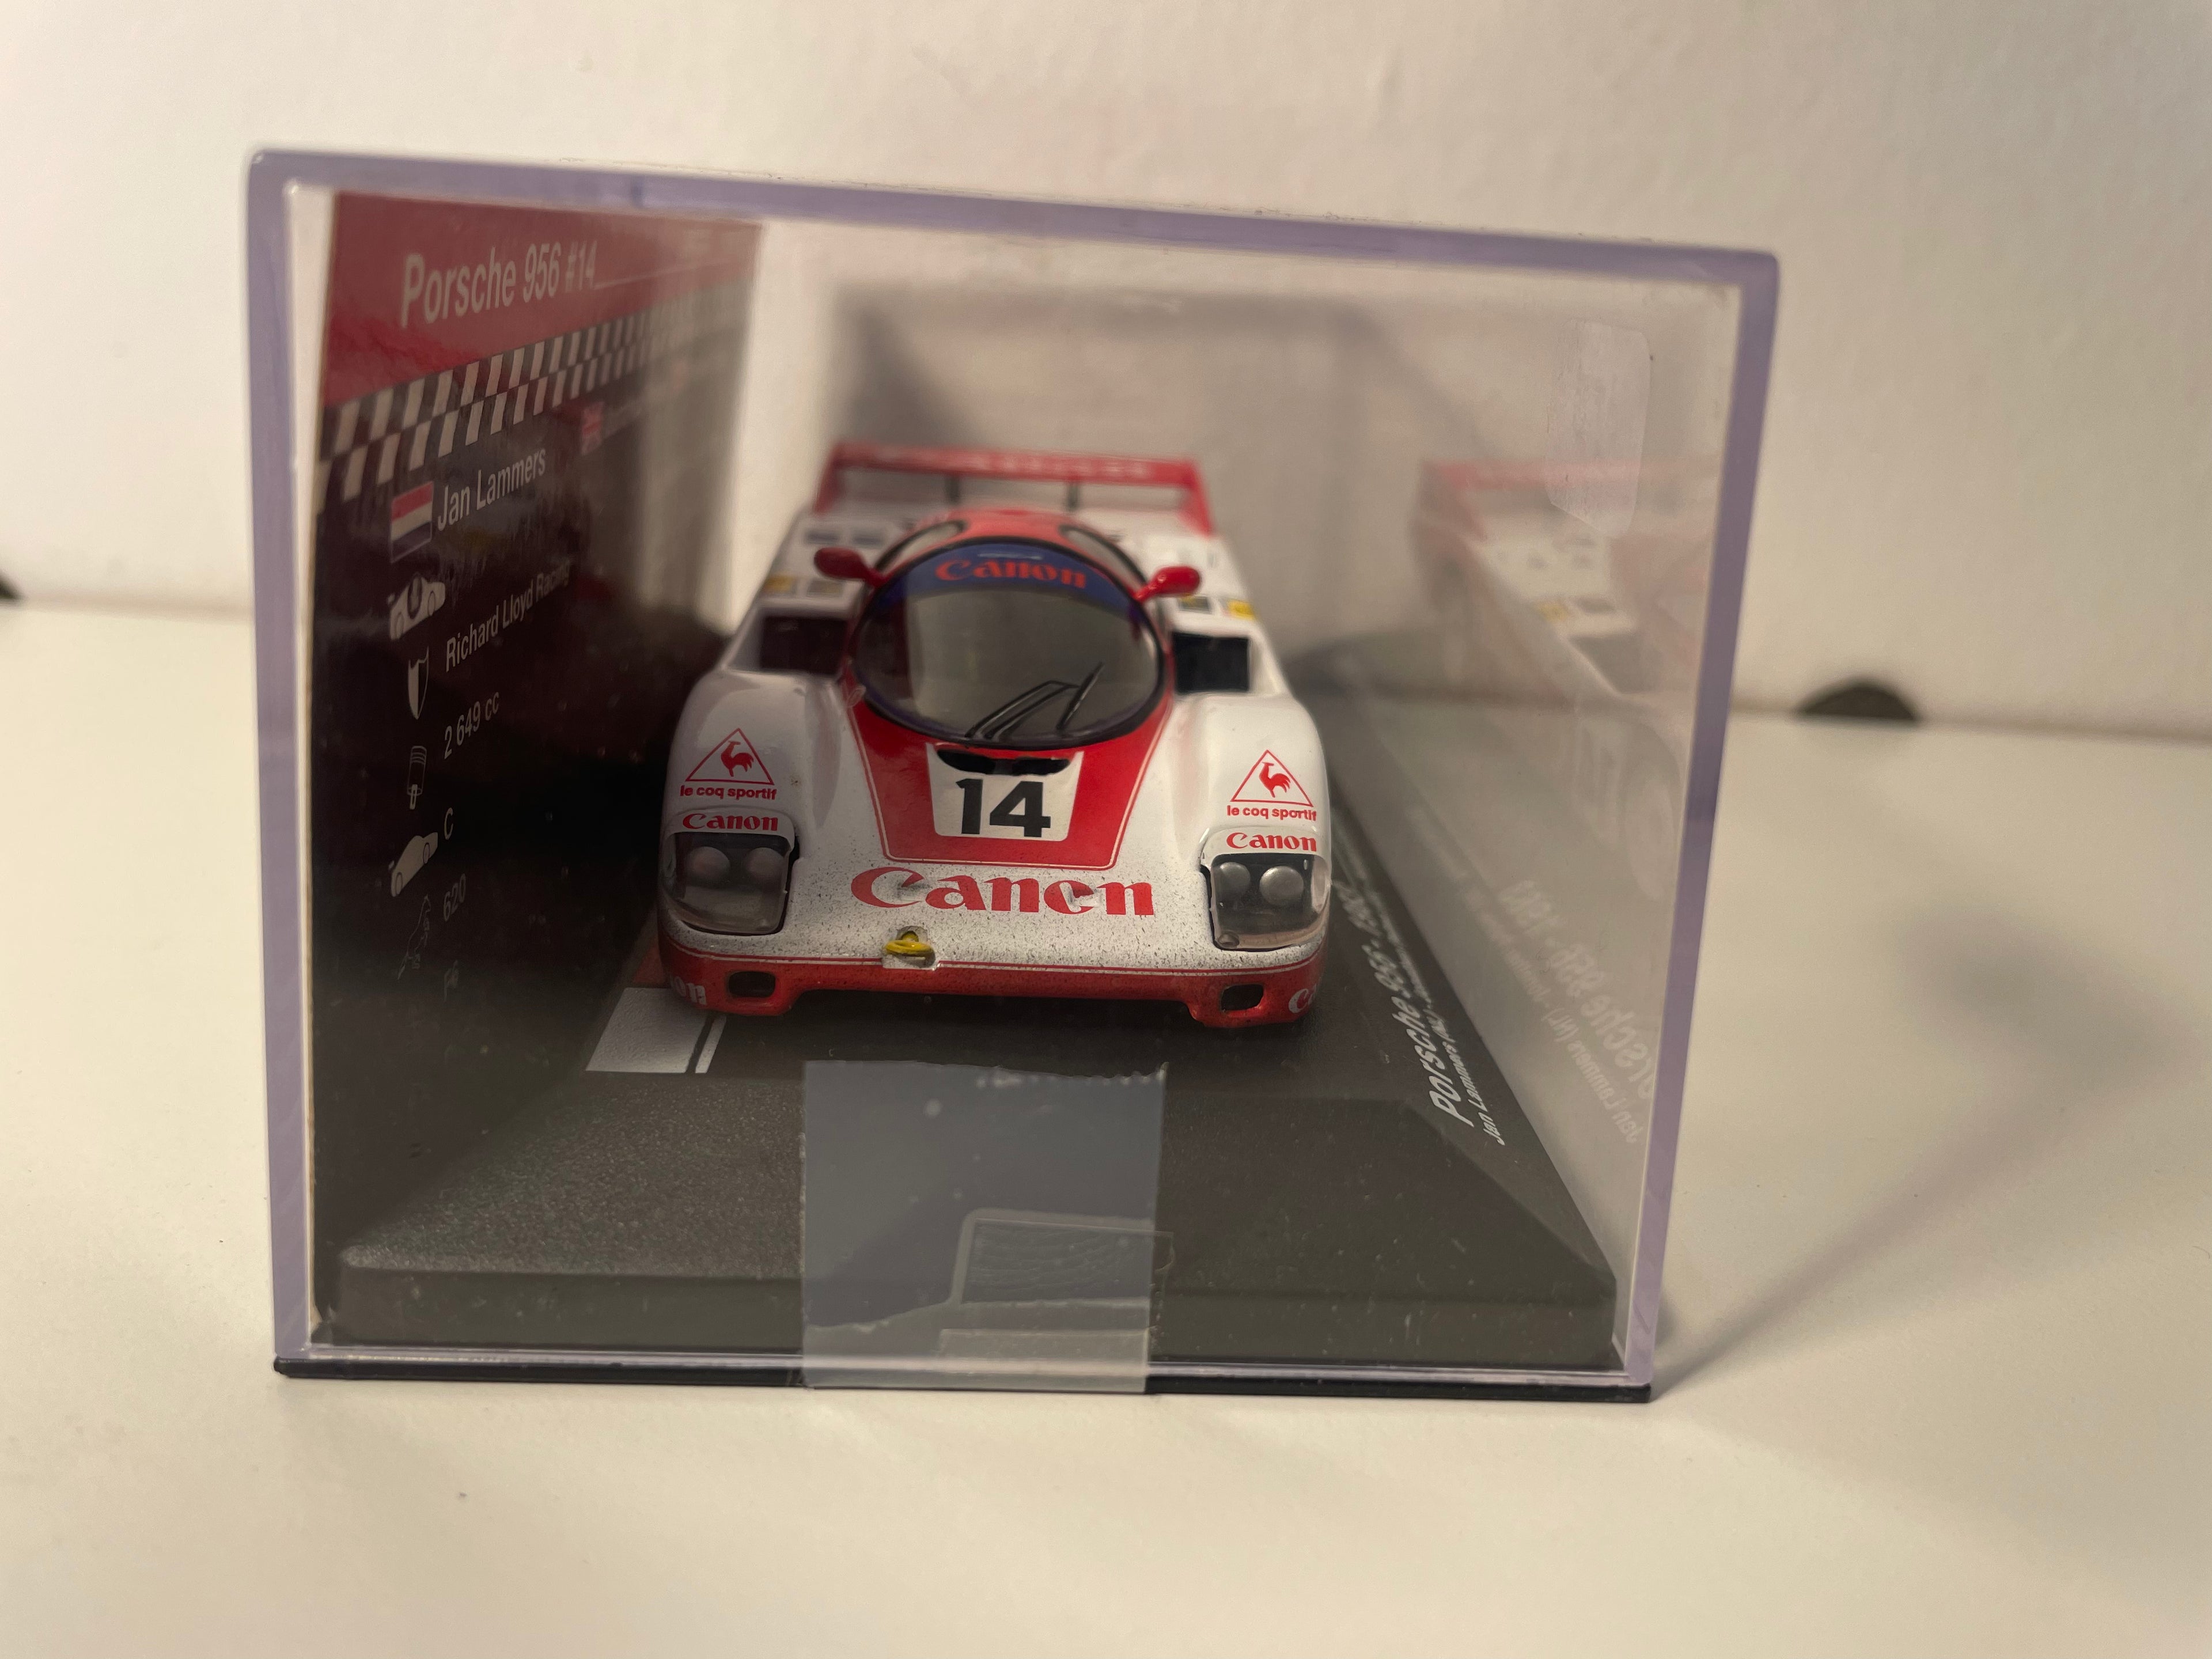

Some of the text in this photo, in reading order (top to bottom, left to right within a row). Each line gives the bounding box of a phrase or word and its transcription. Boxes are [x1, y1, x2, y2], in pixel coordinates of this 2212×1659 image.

[402, 239, 598, 329] Porsche 956 #14
[438, 449, 546, 531] Jan Lammers
[935, 559, 1086, 589] Canon
[446, 605, 499, 673] Richard
[503, 579, 533, 629] Lloyd
[444, 692, 499, 759] 2 649 cc
[680, 785, 777, 800] le coq sportif
[956, 778, 1051, 838] 14
[1227, 805, 1317, 821] le coq sportif
[444, 807, 454, 840] C
[682, 813, 778, 831] Canon
[1226, 832, 1317, 852] Canon
[443, 873, 467, 922] 620
[850, 865, 1154, 916] Canon
[1391, 996, 1474, 1127] Porsche
[1442, 1041, 1488, 1112] Lammers
[1478, 1112, 1505, 1146] Jan
